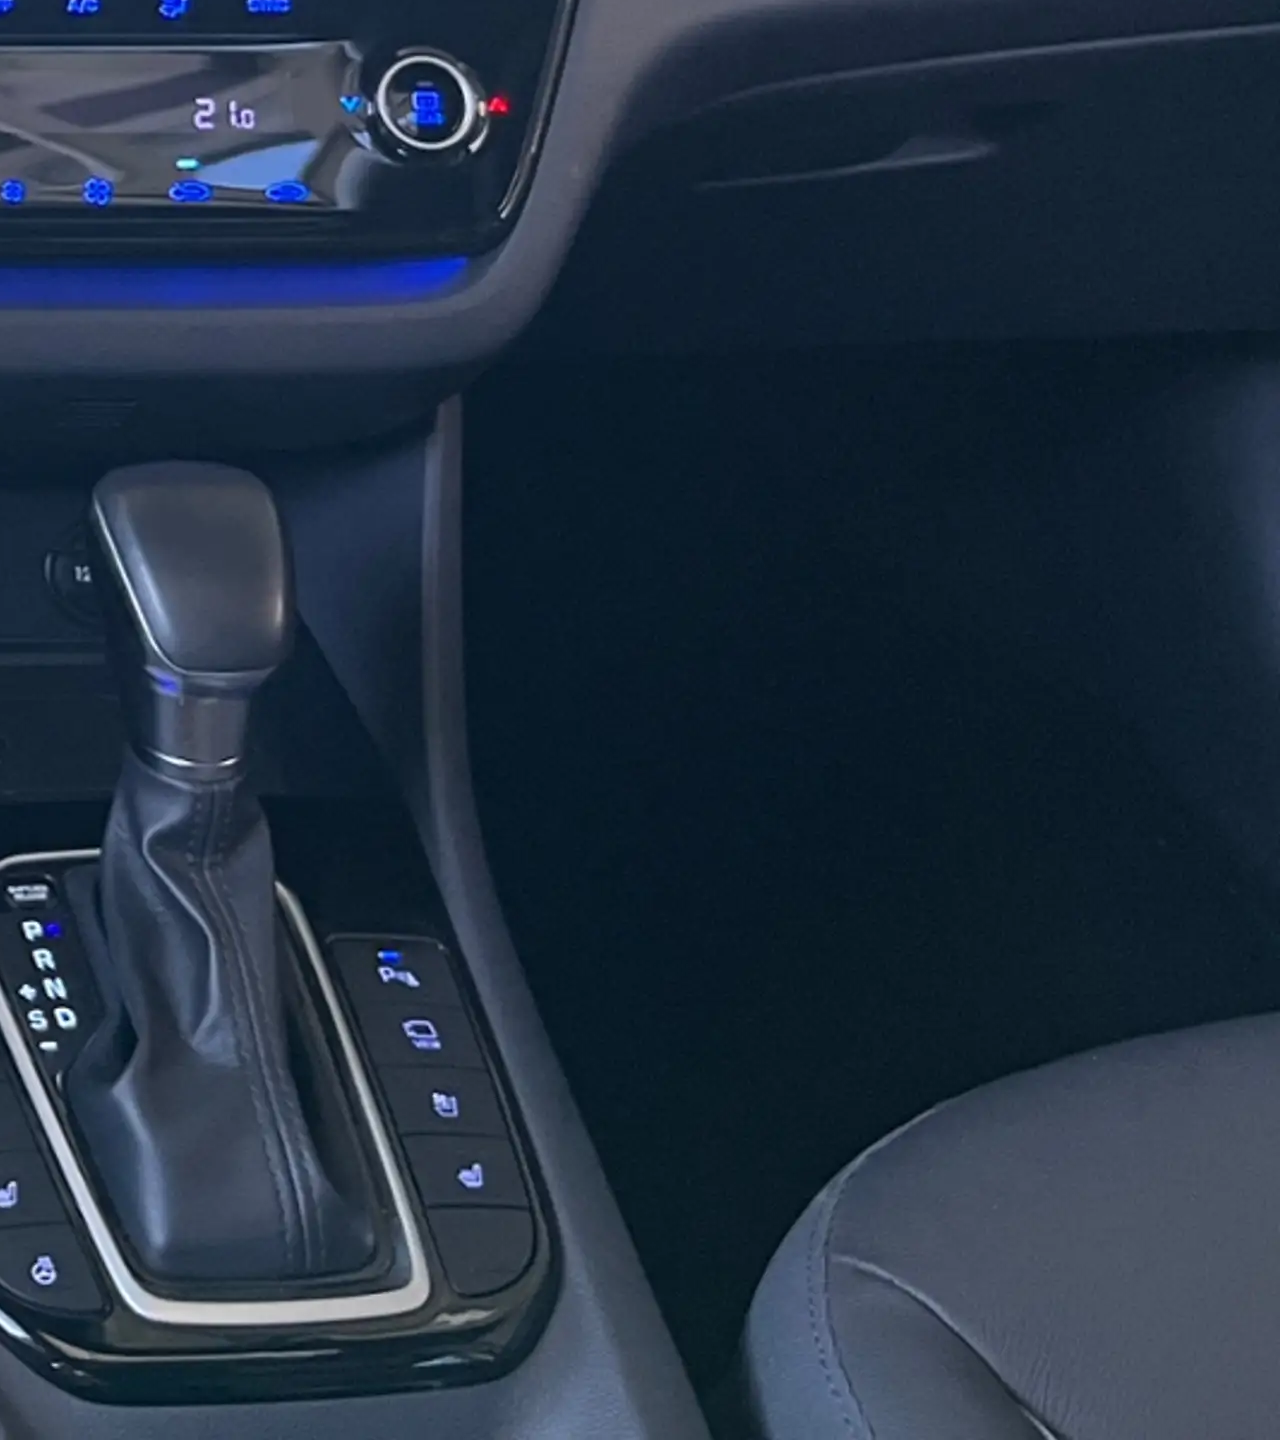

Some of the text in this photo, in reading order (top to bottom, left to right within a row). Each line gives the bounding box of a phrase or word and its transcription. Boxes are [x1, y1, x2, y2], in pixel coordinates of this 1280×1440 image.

[22, 920, 44, 941] P
[32, 947, 56, 971] R
[43, 977, 68, 1000] N
[28, 1007, 78, 1032] S D
